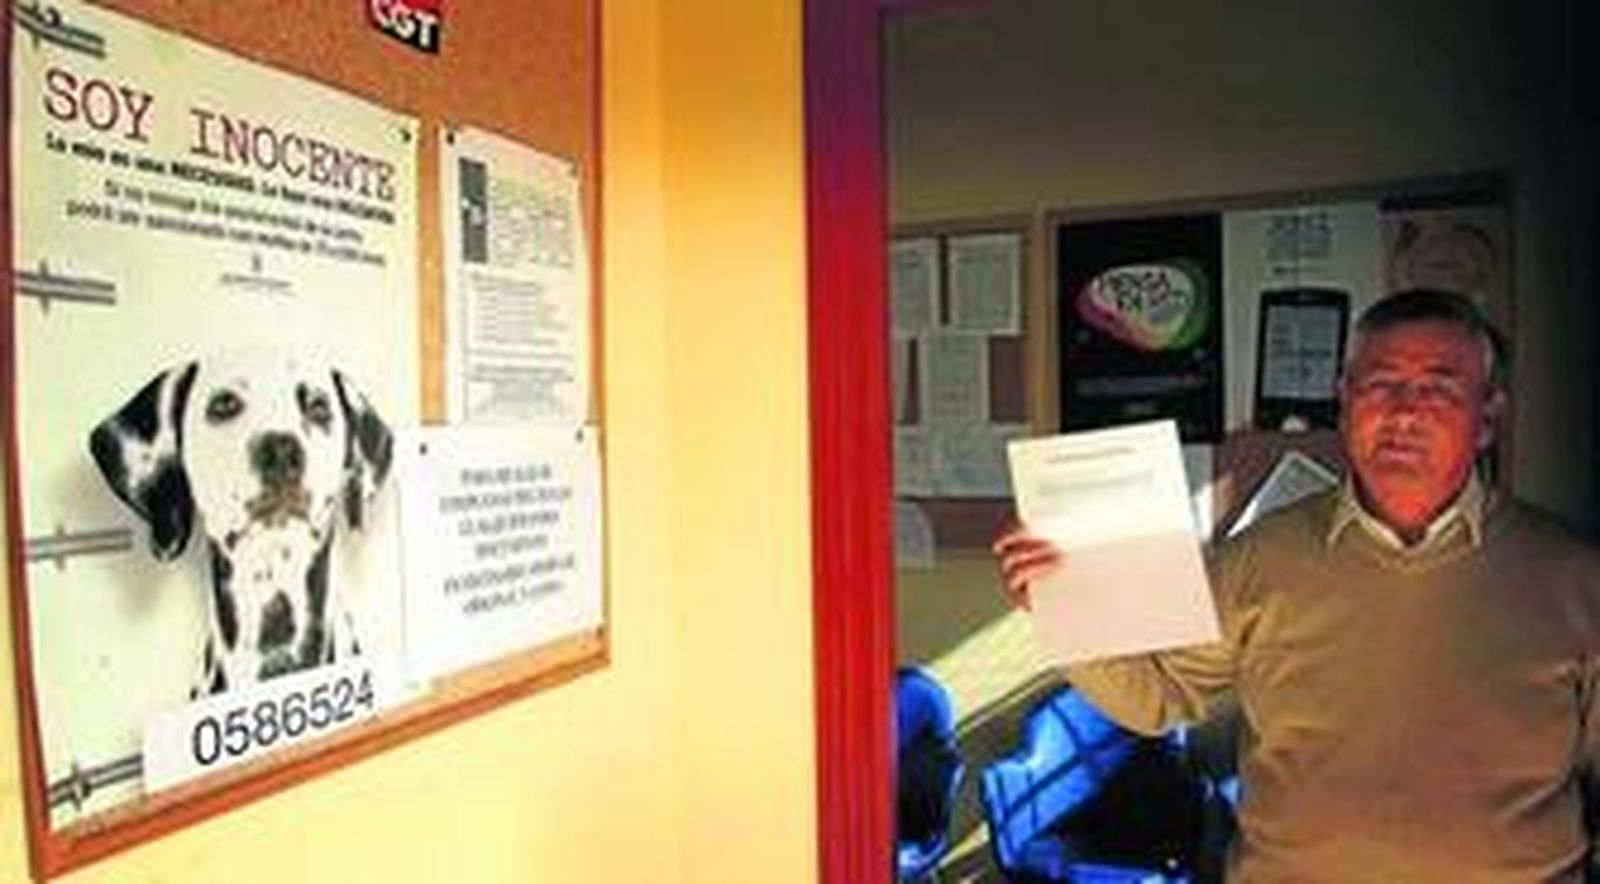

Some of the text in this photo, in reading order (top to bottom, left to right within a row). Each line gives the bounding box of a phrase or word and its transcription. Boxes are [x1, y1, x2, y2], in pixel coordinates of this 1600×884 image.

[45, 68, 396, 201] SOY INOCENTE
[193, 671, 375, 765] 0586524
